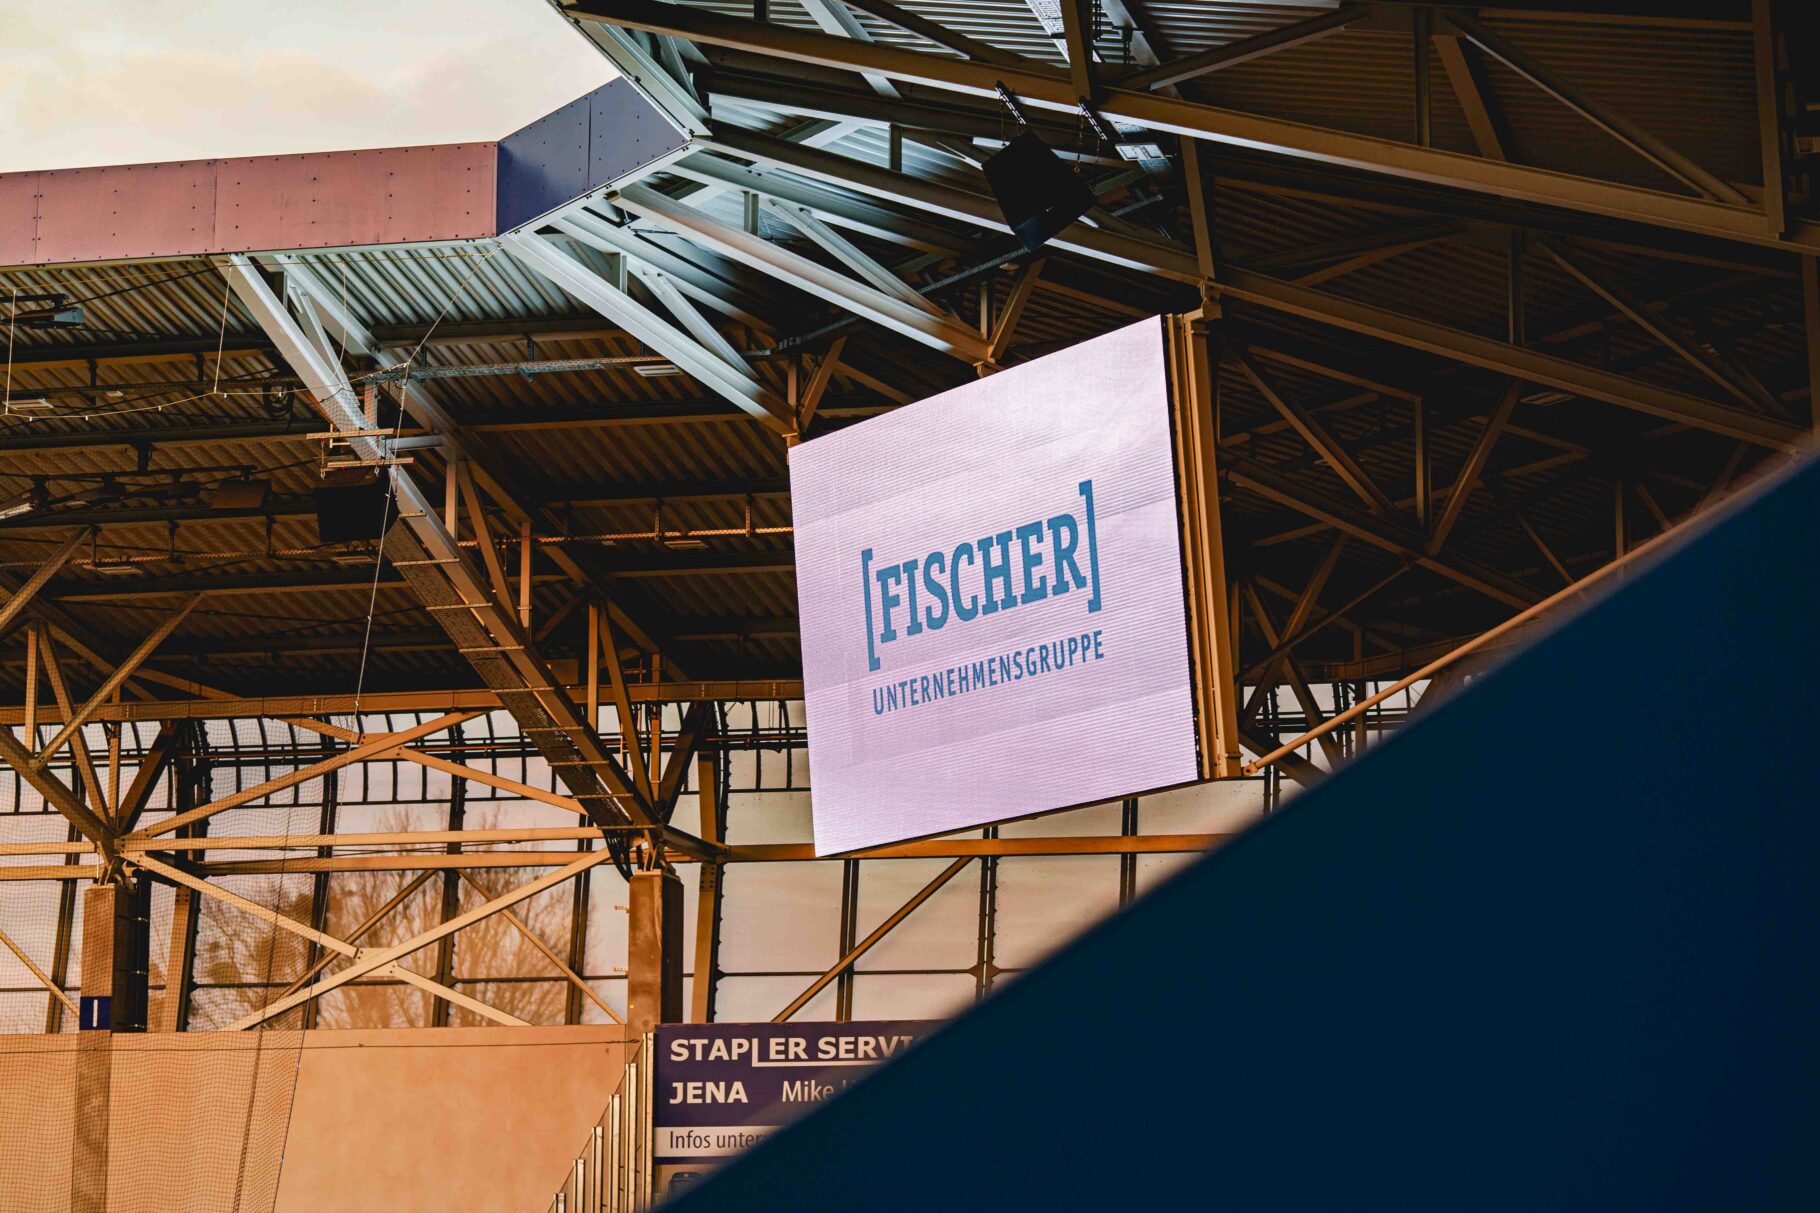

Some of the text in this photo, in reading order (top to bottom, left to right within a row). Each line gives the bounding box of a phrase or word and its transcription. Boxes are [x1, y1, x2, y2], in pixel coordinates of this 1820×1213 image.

[873, 630, 1104, 715] UNTERNEHMENSGRUPPE
[670, 1035, 924, 1067] STAPLER SERVI
[669, 1081, 749, 1104] JENA
[782, 1079, 835, 1102] Mike
[669, 1130, 711, 1149] Infos
